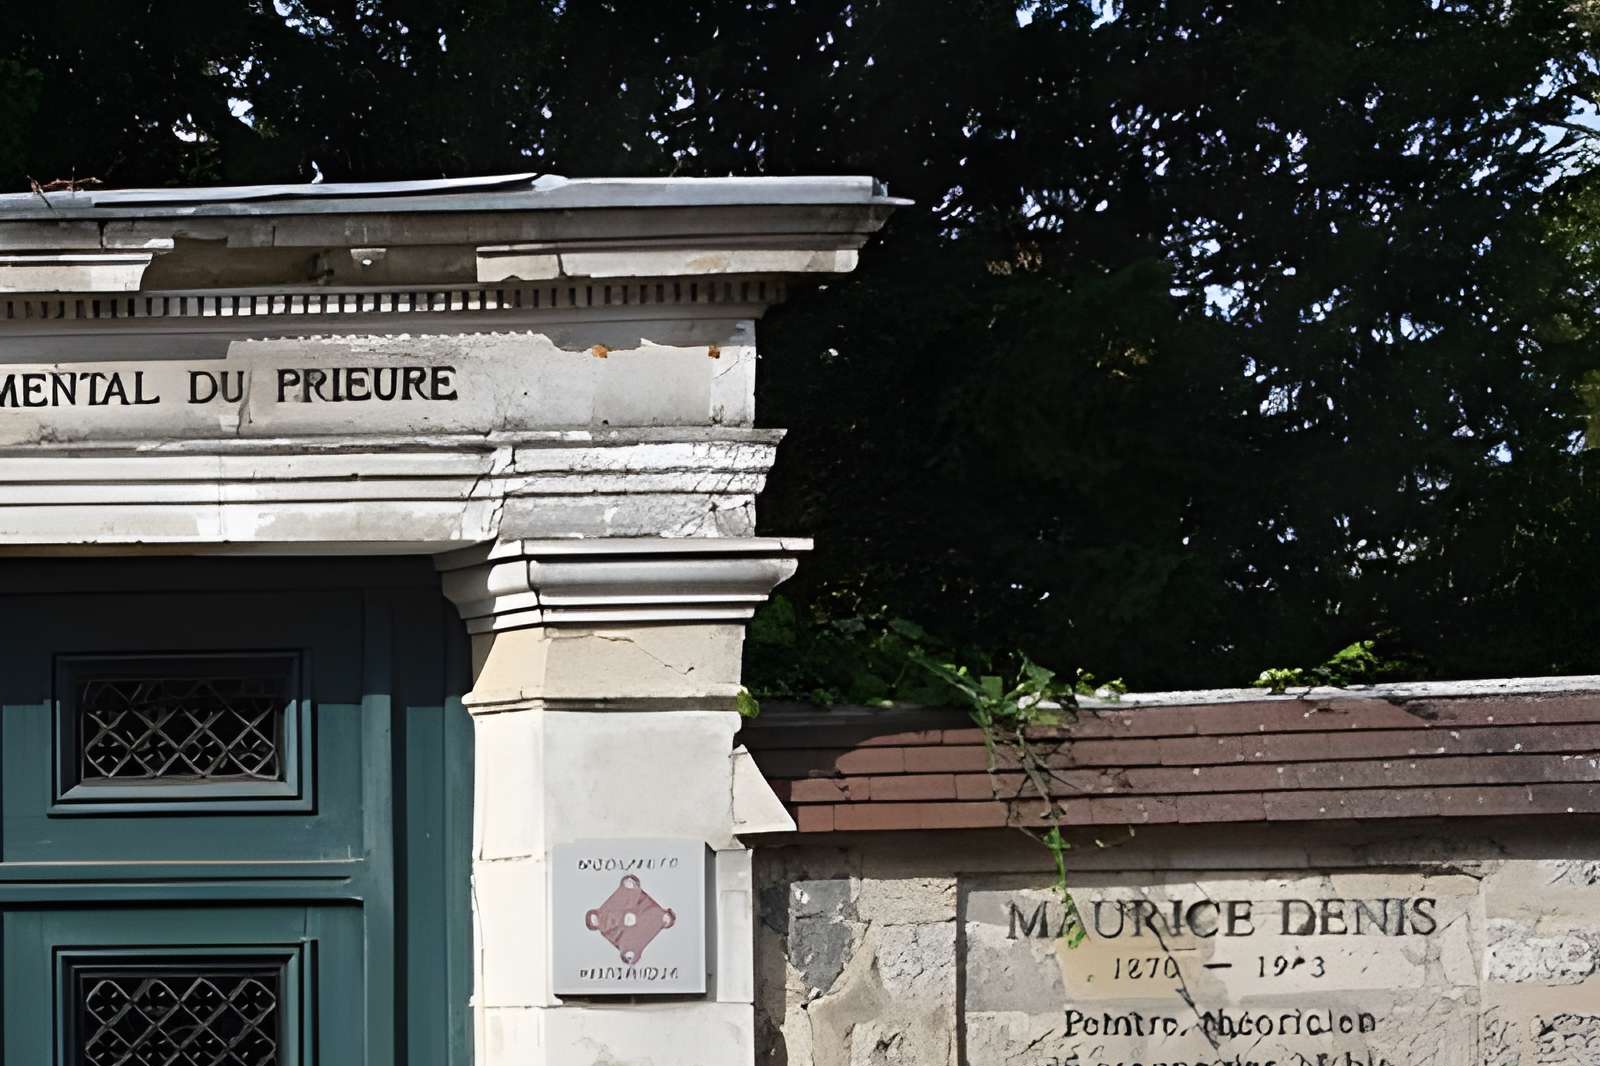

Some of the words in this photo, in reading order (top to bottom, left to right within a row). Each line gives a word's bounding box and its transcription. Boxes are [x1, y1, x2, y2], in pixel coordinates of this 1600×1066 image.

[188, 369, 246, 403] DU
[277, 366, 458, 402] PRIEURE
[1006, 898, 1257, 941] MAURICE
[1280, 898, 1438, 938] DENIS
